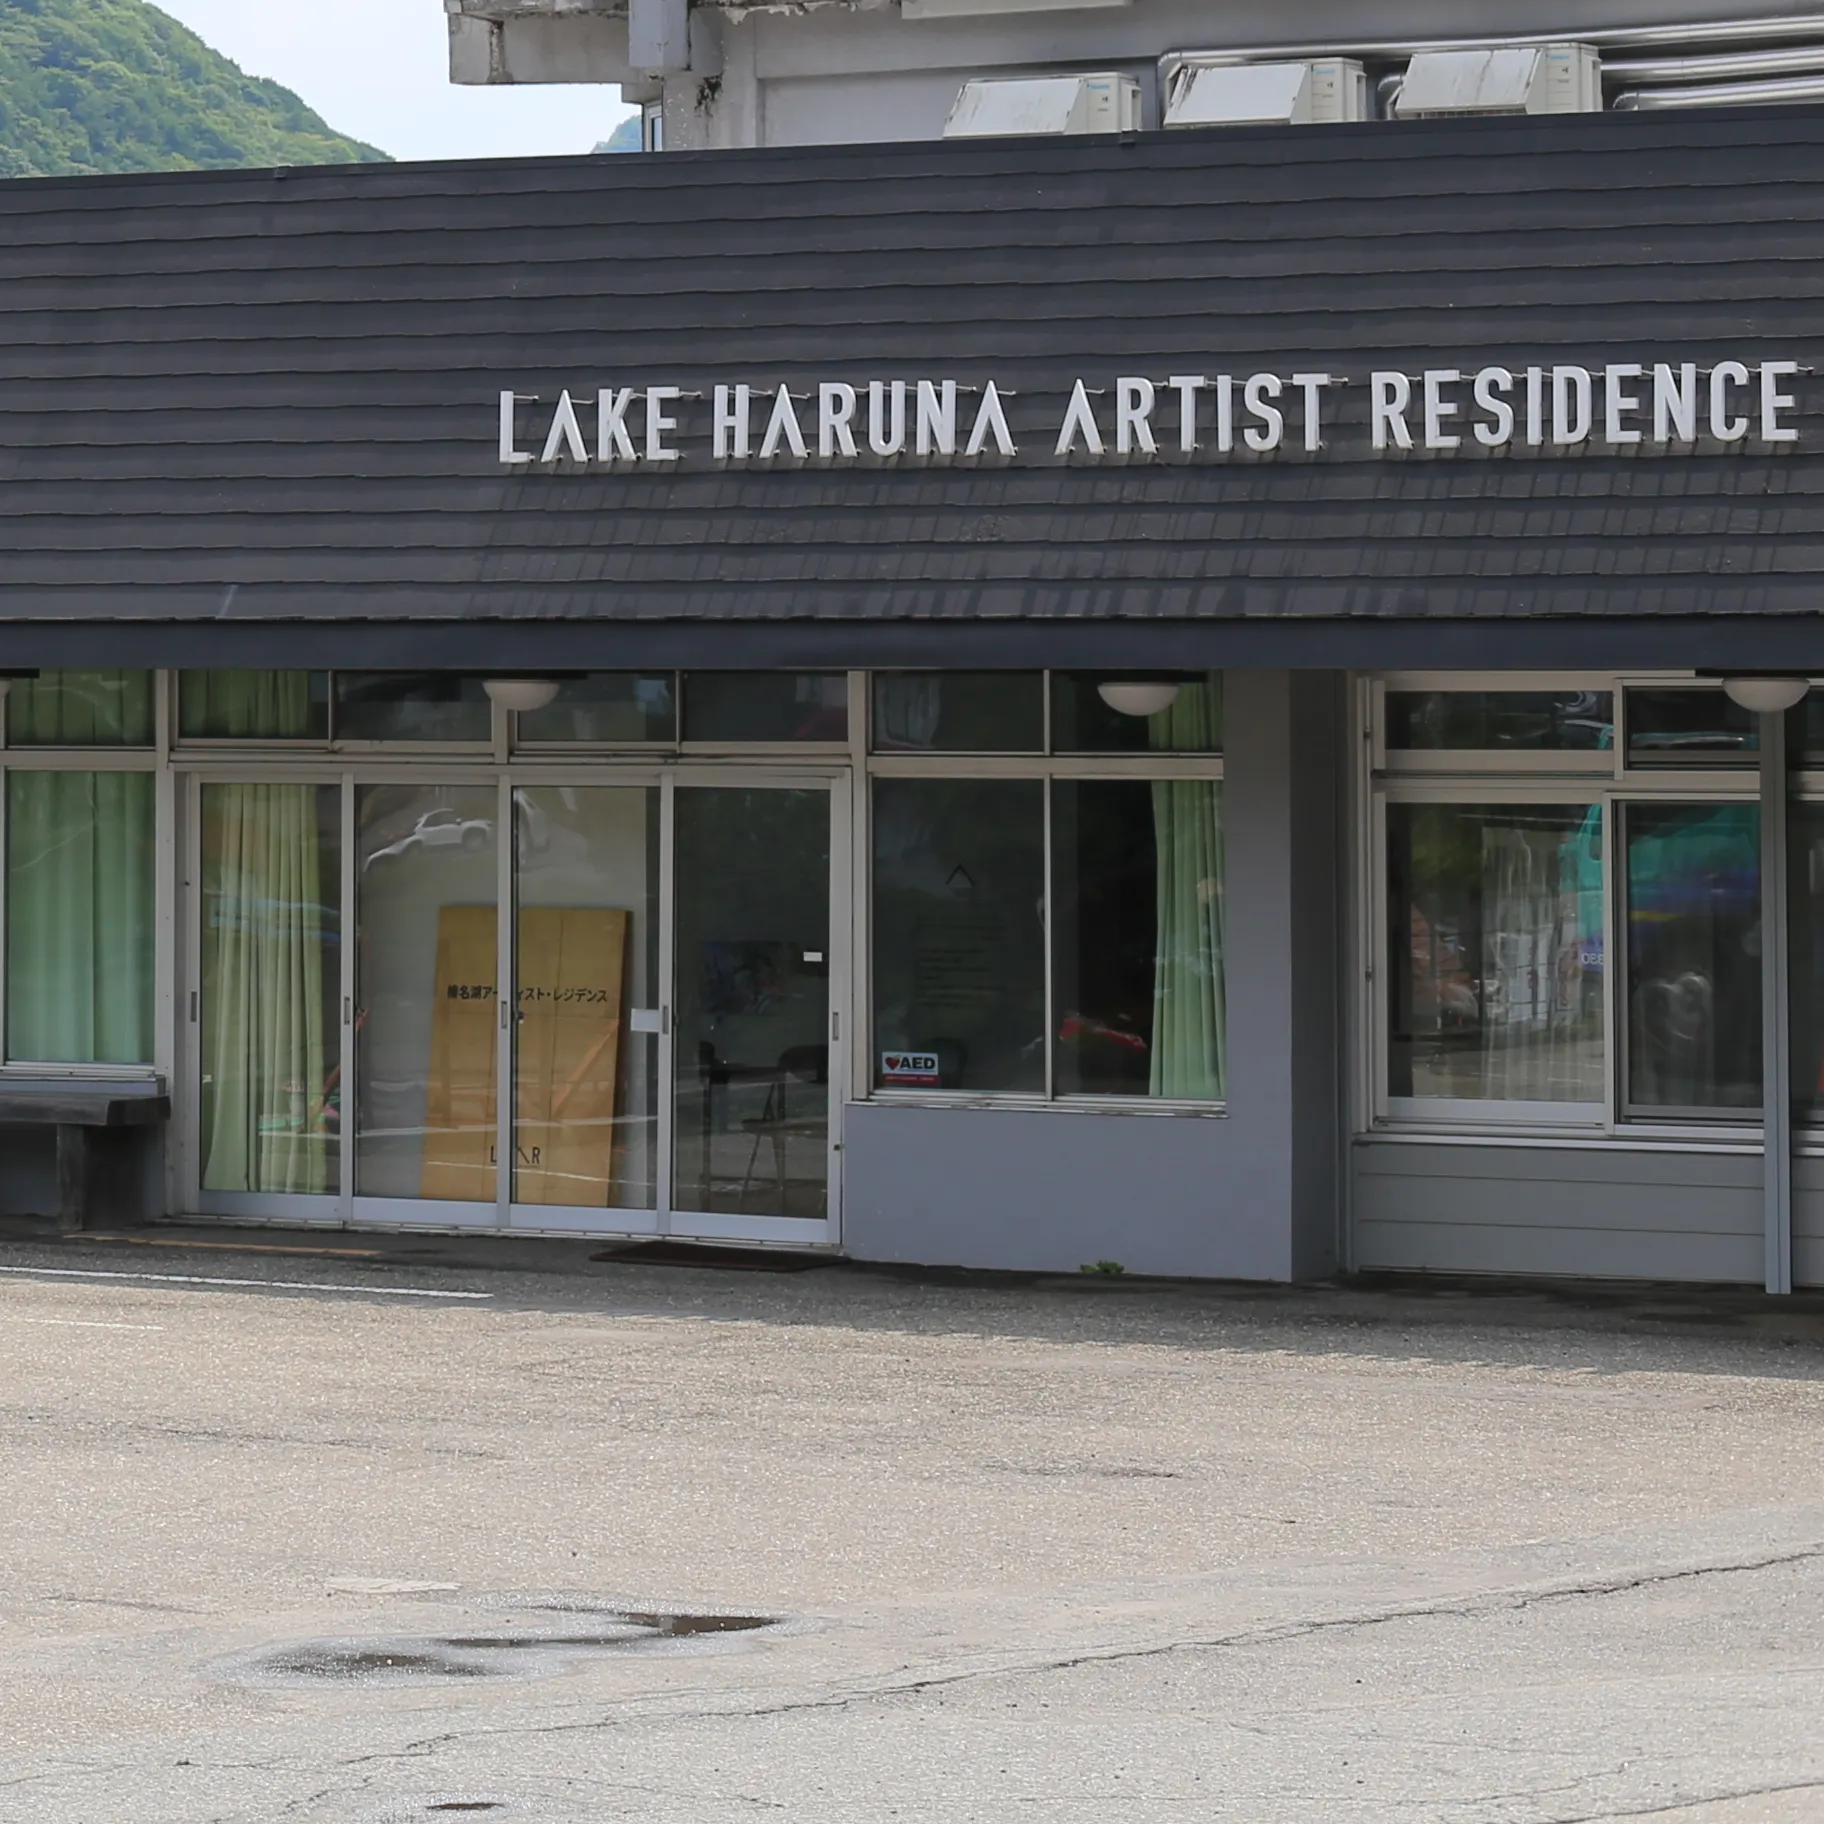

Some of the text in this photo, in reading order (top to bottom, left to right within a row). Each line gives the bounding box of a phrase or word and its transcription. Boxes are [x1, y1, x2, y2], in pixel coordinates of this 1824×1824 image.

[498, 360, 1801, 464] LAKE HARUNA ARTIST RESIDENCE
[900, 1056, 936, 1070] AED
